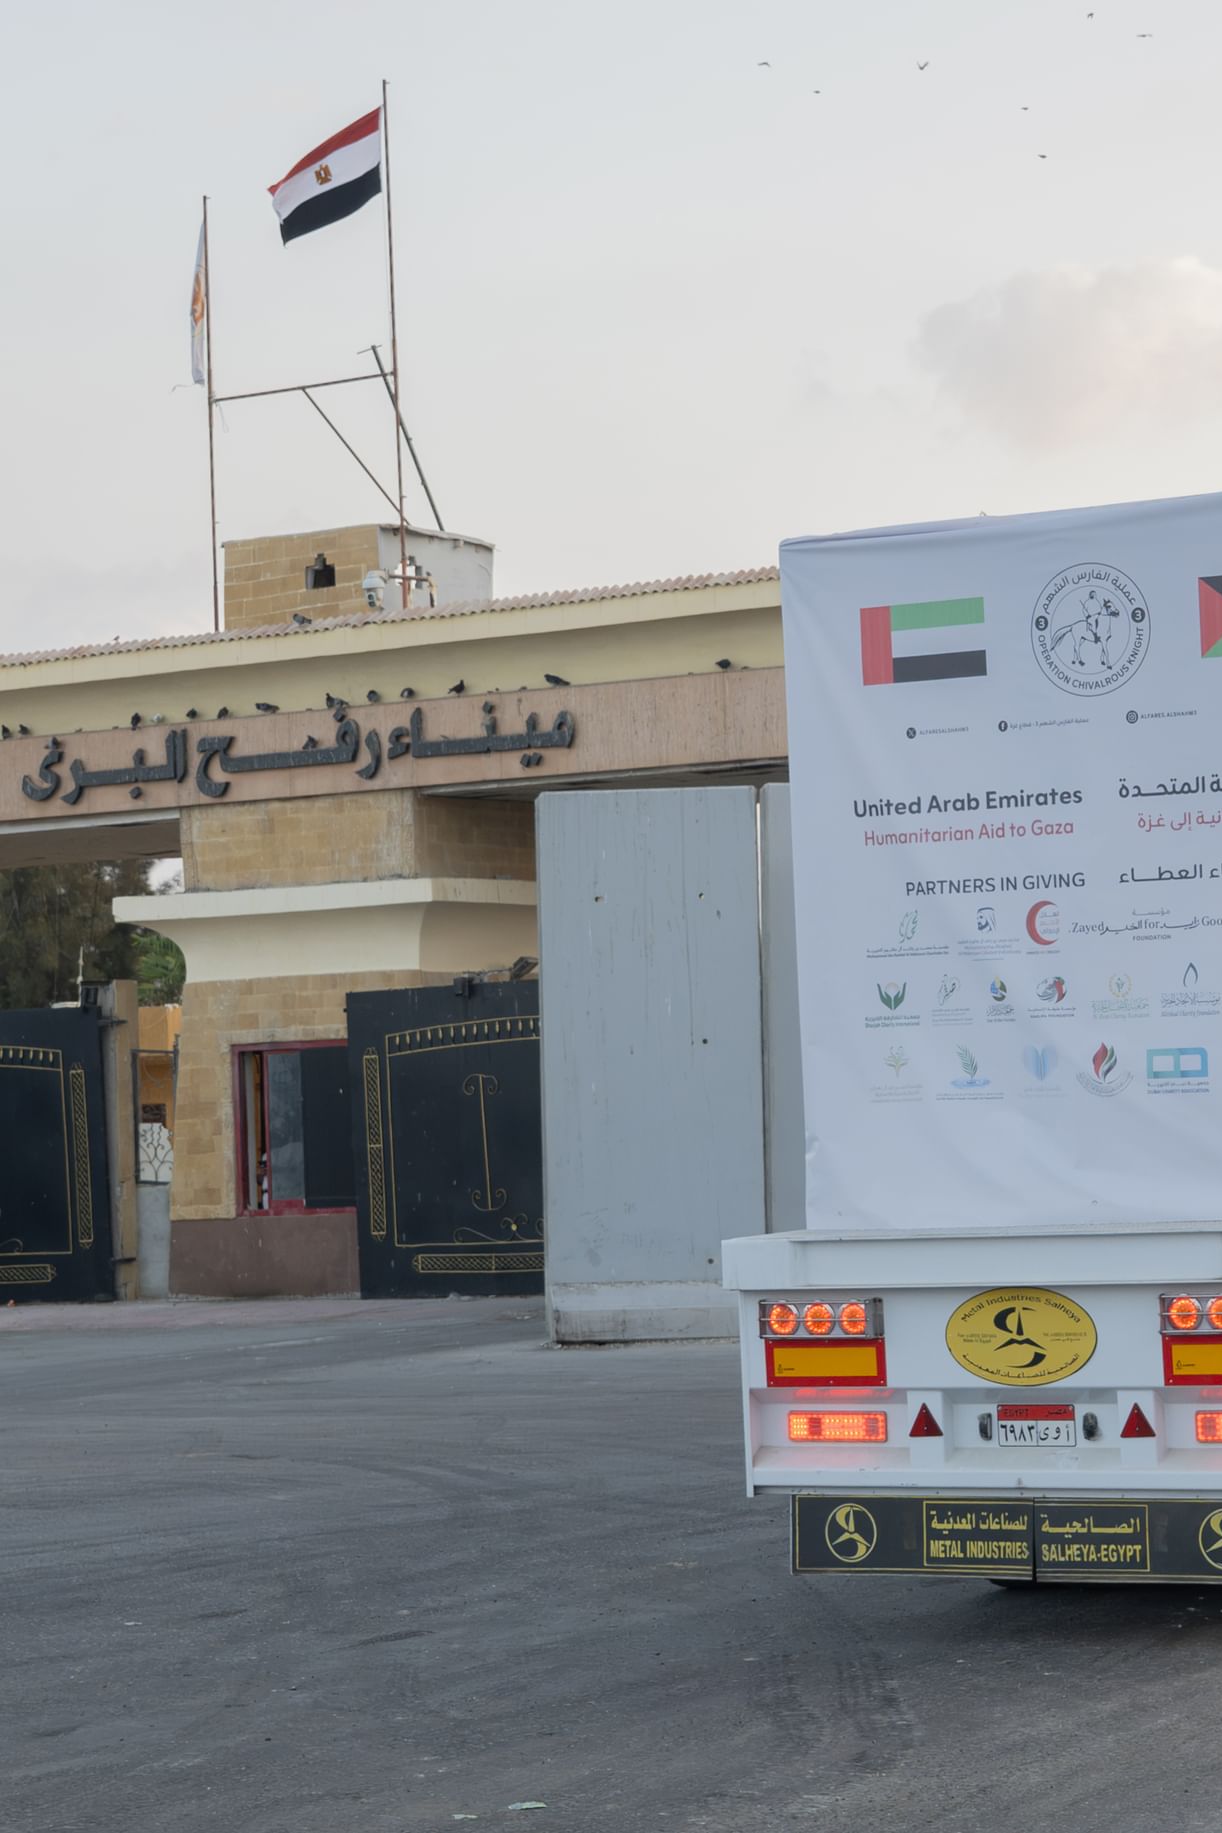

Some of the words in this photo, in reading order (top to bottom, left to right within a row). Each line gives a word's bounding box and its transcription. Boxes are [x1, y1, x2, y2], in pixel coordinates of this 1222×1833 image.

[1038, 634, 1072, 685] OPERATION
[1071, 663, 1130, 690] CHIVALROUS
[1126, 627, 1145, 666] KNIGHT
[387, 701, 575, 768] ميناء
[196, 708, 382, 799] رفح
[1118, 776, 1206, 799] المتحدة
[853, 796, 923, 818] United
[926, 793, 981, 814] Arab
[985, 788, 1084, 809] Emirates
[864, 826, 975, 847] Humanitarian
[978, 822, 1006, 840] Aid
[1009, 822, 1027, 838] to
[1030, 819, 1075, 836] Gaza
[1137, 812, 1166, 833] غزة
[1170, 812, 1192, 832] إلى
[905, 877, 997, 897] PARTNERS
[1000, 876, 1018, 892] IN
[1022, 871, 1086, 891] GIVING
[1118, 863, 1203, 884] العطاء
[960, 1302, 986, 1323] Metal
[985, 1294, 1041, 1307] Industries
[1043, 1297, 1082, 1324] Salheya
[930, 1510, 976, 1535] المعدنية
[979, 1511, 1028, 1531] للصناعات
[1040, 1512, 1141, 1539] الصالحية
[930, 1540, 964, 1559] METAL
[966, 1540, 1029, 1560] INDUSTRIES
[1041, 1543, 1142, 1563] SALHEYA-EGYPT
